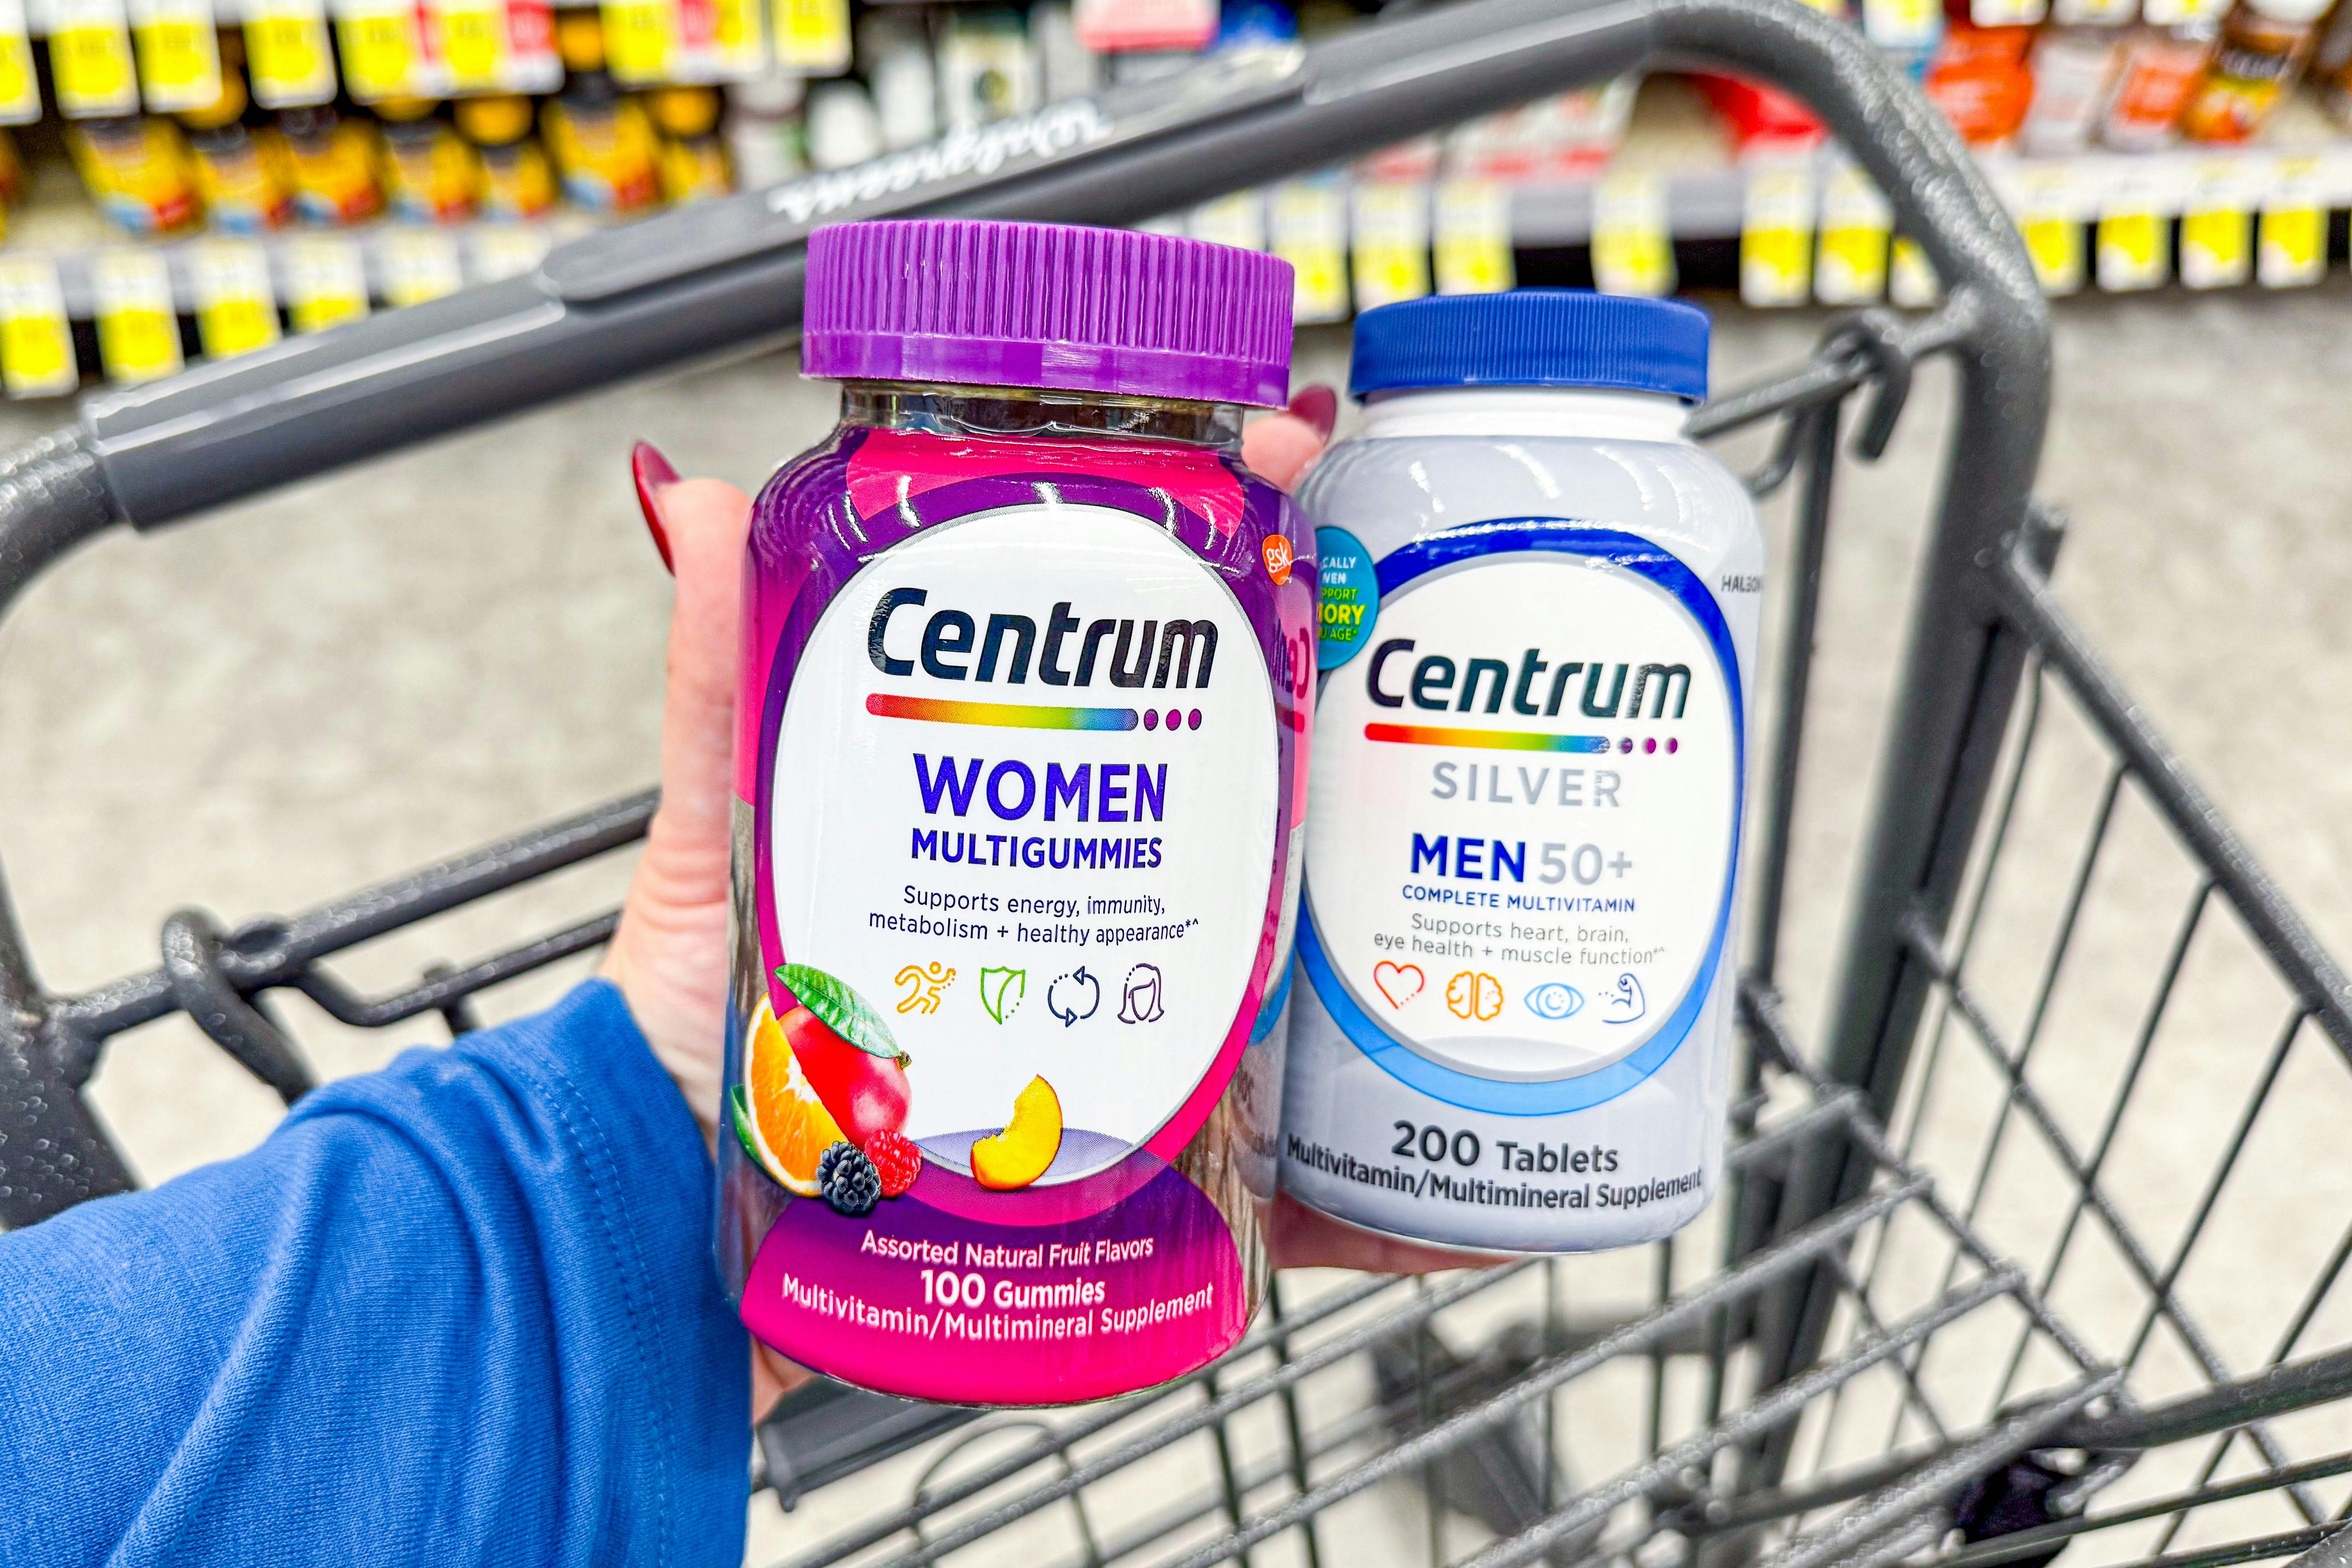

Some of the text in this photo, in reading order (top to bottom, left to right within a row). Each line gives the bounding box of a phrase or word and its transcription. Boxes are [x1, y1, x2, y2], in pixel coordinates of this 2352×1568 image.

[1266, 542, 1291, 573] gsk
[868, 587, 1218, 688] Centrum
[1366, 639, 1691, 719] Centrum
[913, 753, 1168, 822] WOMEN
[1431, 761, 1621, 807] SILVER
[912, 828, 1162, 868] MULTIGUMMIES
[1410, 832, 1632, 885] MEN 50+
[904, 885, 1165, 917] Supports energy, immunity,
[1403, 885, 1635, 913] COMPLETE MULTIVITAMIN
[869, 910, 988, 940] metabolism
[997, 925, 1009, 938] +
[1018, 923, 1090, 946] healthy
[1411, 913, 1629, 943] Supports heart, brain,
[1374, 933, 1404, 950] eye
[1412, 934, 1472, 957] health
[1483, 946, 1494, 956] +
[1502, 947, 1571, 964] muscle
[1392, 1119, 1618, 1173] 200 Tablets
[1287, 1133, 1701, 1209] Multivitamin/Multimineral Supplement
[860, 1230, 1153, 1267] Assorted Natural Fruit Flavors
[782, 1272, 1214, 1340] Multivitamin/Multimineral Supplement
[921, 1269, 1105, 1308] 100 Gummies
